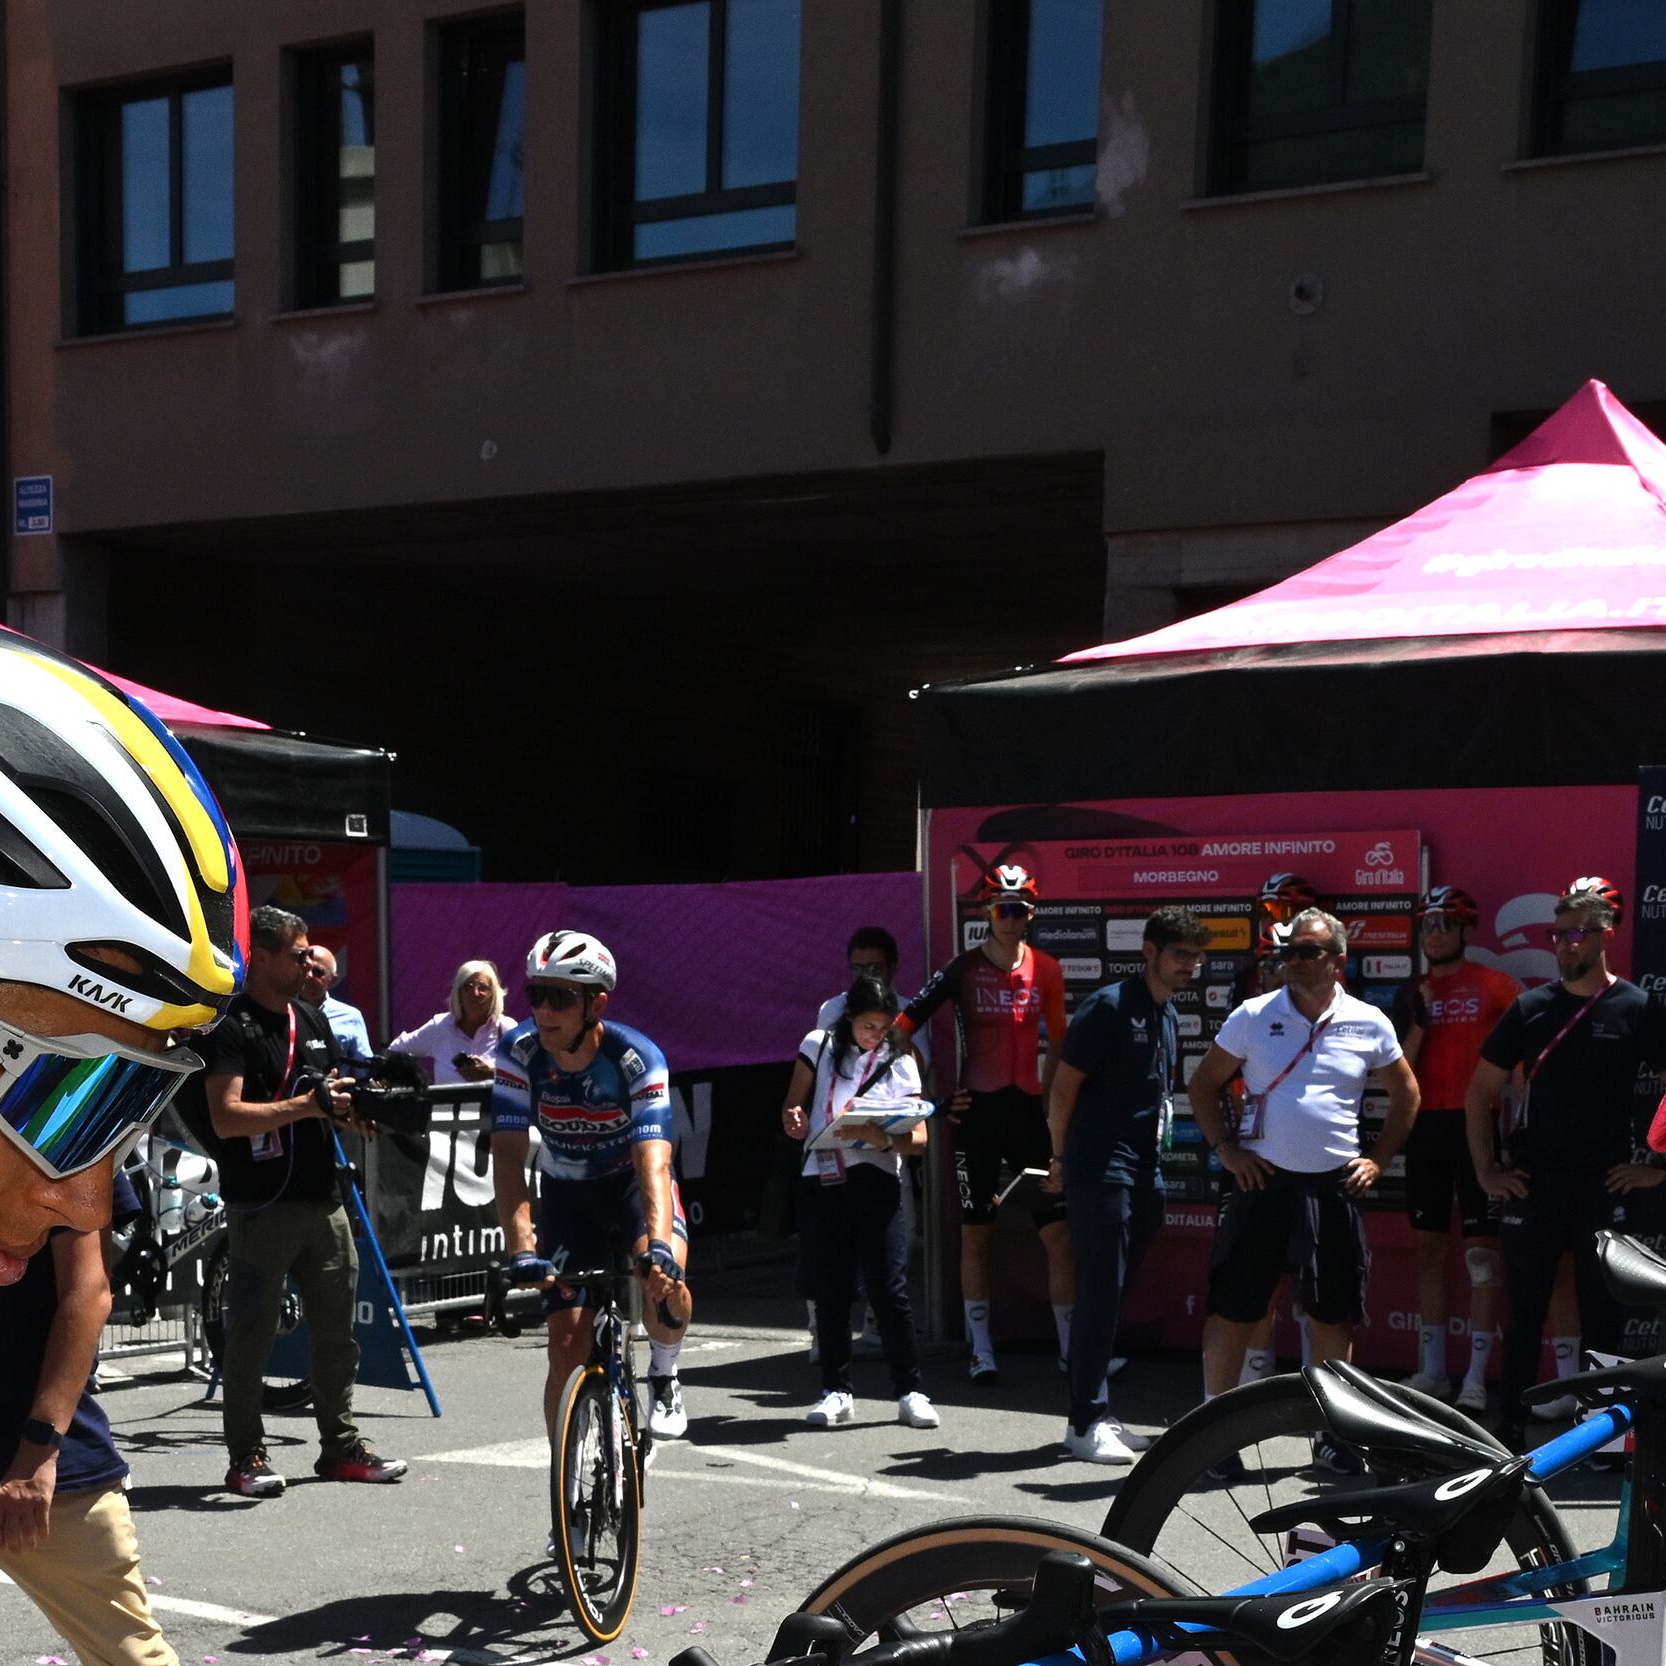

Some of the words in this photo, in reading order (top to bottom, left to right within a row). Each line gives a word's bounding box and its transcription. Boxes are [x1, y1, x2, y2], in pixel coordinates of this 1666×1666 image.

[1201, 842, 1262, 857] AMORE
[1264, 839, 1336, 854] INFINITO
[1133, 869, 1220, 884] MORBEGNO
[1355, 869, 1374, 886] Giro
[1065, 905, 1102, 915] INFINITO
[1187, 903, 1212, 913] MORE
[1214, 903, 1252, 913] INFINITO
[1336, 901, 1368, 912] AMORE
[1370, 900, 1412, 911] INFINITO
[67, 974, 134, 1014] KASK
[976, 987, 1040, 1006] INEOS
[1431, 997, 1480, 1017] EOS
[540, 1113, 630, 1135] SOUDAL
[954, 1150, 974, 1210] INEOS
[1594, 1602, 1654, 1617] BAHRAIN
[1596, 1611, 1655, 1624] VICTORIOUS
